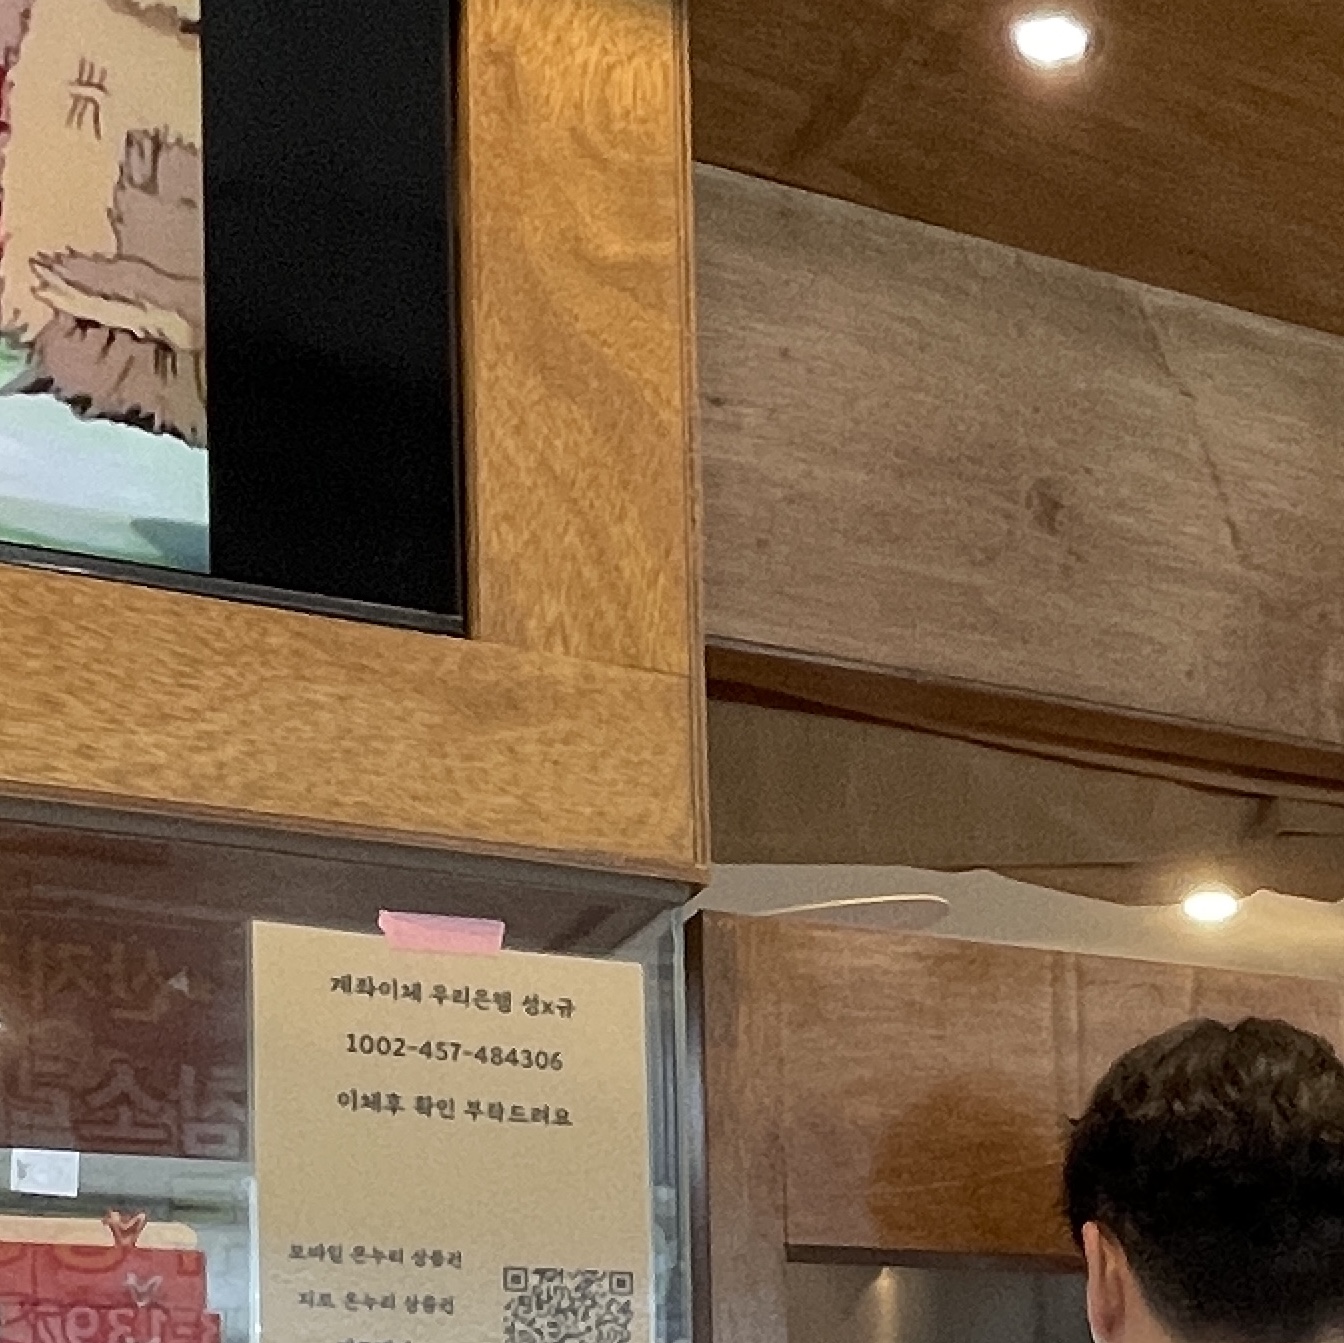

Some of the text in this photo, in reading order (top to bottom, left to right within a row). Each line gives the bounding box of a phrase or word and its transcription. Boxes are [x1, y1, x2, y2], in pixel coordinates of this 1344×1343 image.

[330, 973, 421, 1003] 계좌이체
[429, 984, 512, 1014] 우리은행
[346, 1032, 564, 1071] 1002-457-484306
[336, 1088, 574, 1127] 이체후 확인 부탁드려요
[289, 1243, 462, 1270] 모바일 온누리 상품권
[343, 1291, 396, 1312] 온누리
[404, 1293, 454, 1316] 상품권
